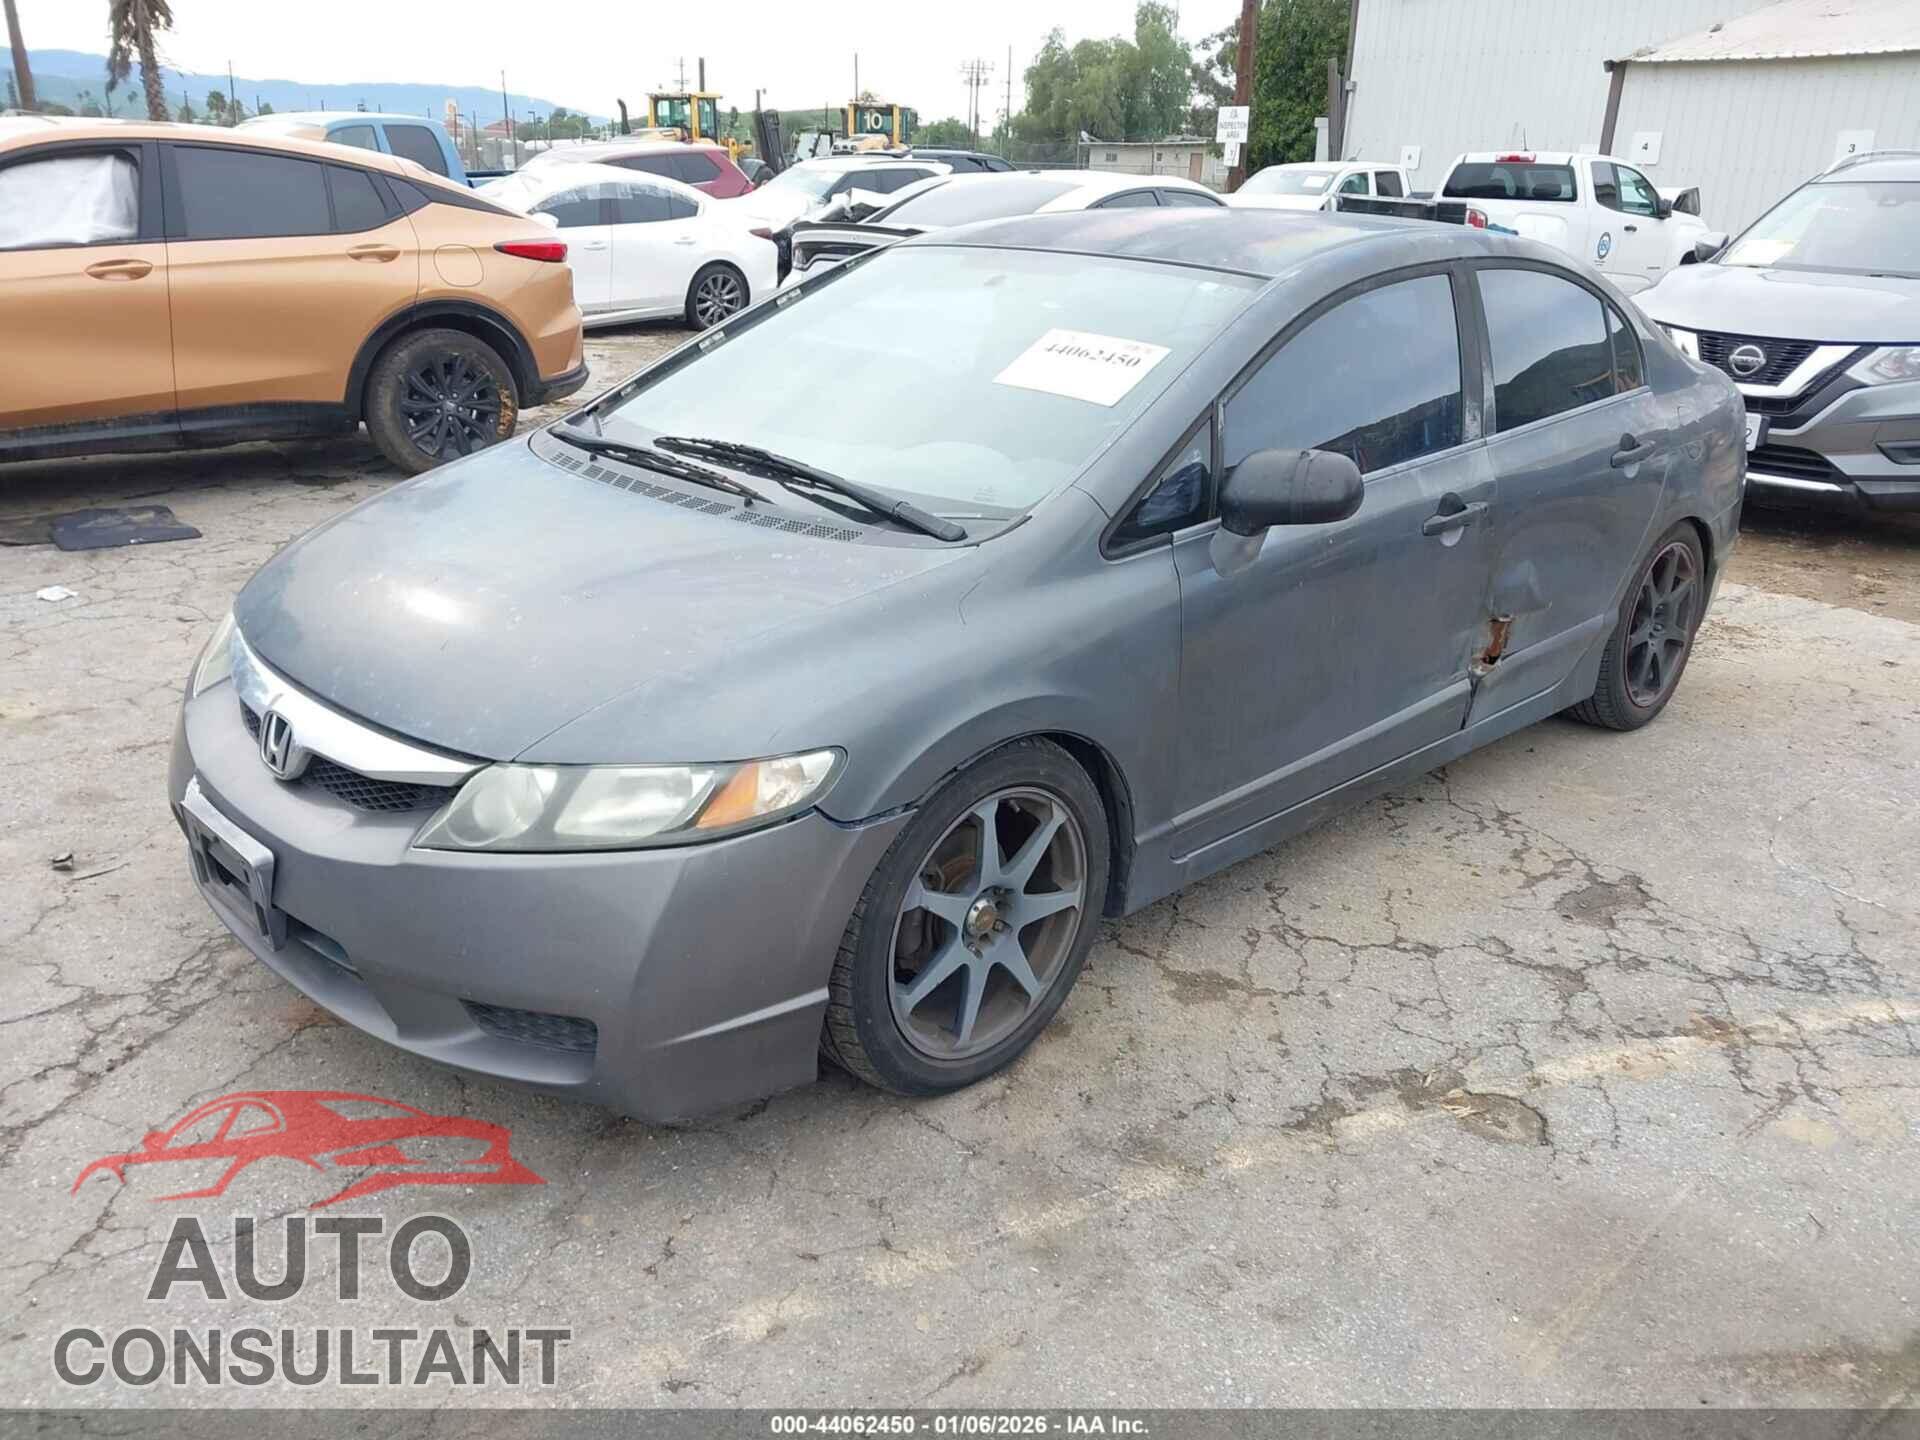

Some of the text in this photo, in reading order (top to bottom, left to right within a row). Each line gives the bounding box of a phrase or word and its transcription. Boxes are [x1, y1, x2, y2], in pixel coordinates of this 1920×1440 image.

[864, 112, 883, 129] 10
[1641, 142, 1649, 151] 4
[1848, 143, 1856, 153] 3
[1044, 342, 1142, 367] 44062450
